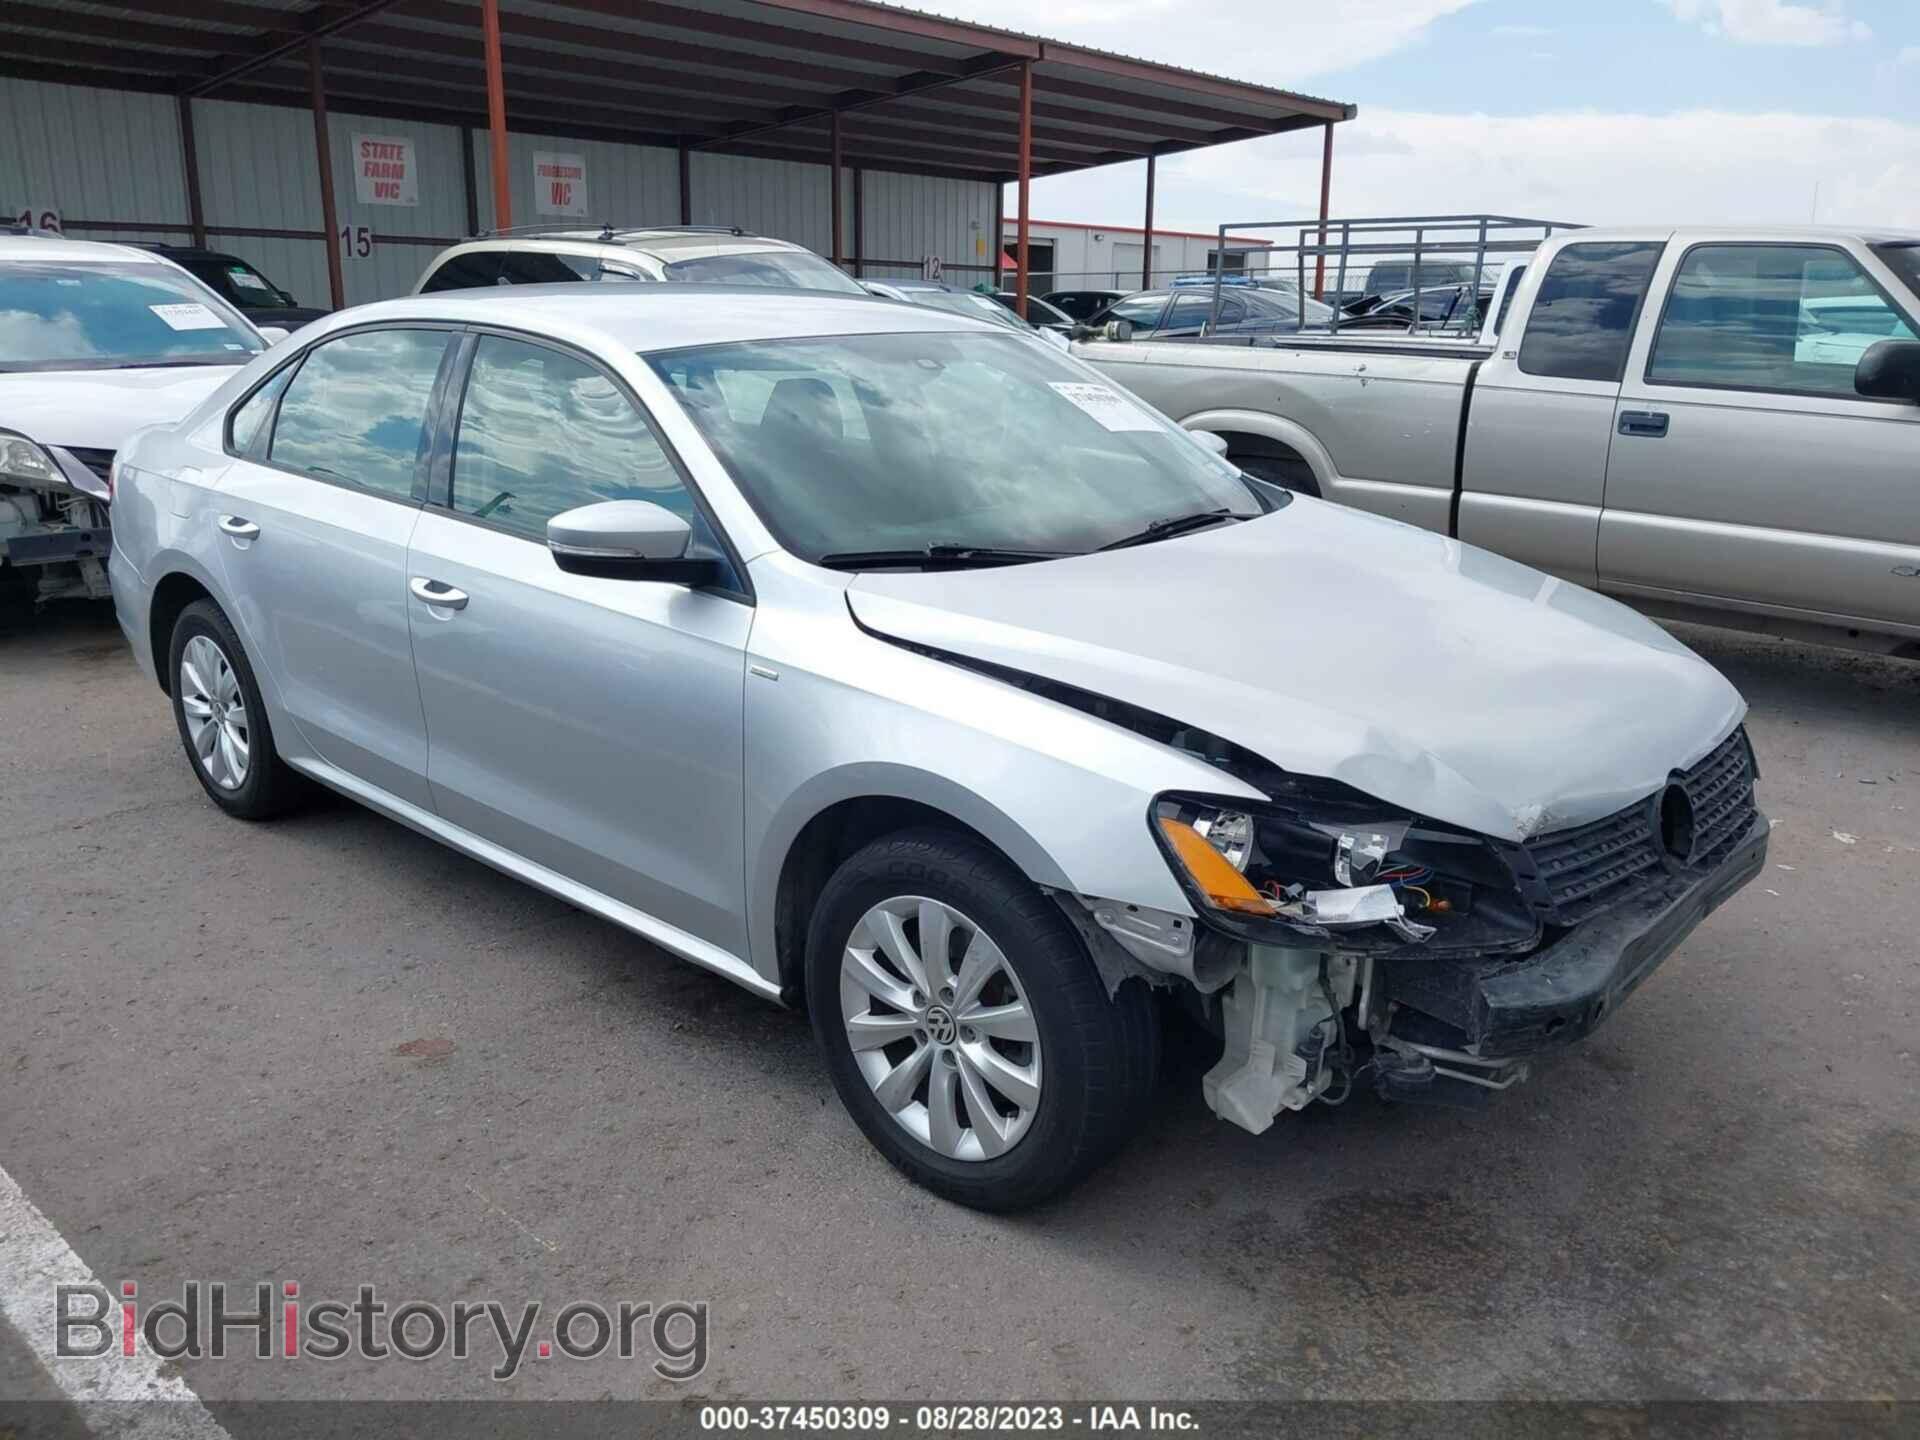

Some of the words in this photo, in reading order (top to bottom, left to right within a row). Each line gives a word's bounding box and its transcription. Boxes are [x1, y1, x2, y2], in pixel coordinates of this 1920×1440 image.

[361, 141, 405, 160] STATE
[364, 161, 405, 179] FARM
[374, 182, 401, 200] VIC
[551, 182, 572, 206] VIC
[341, 226, 371, 258] 15
[923, 256, 941, 280] 12
